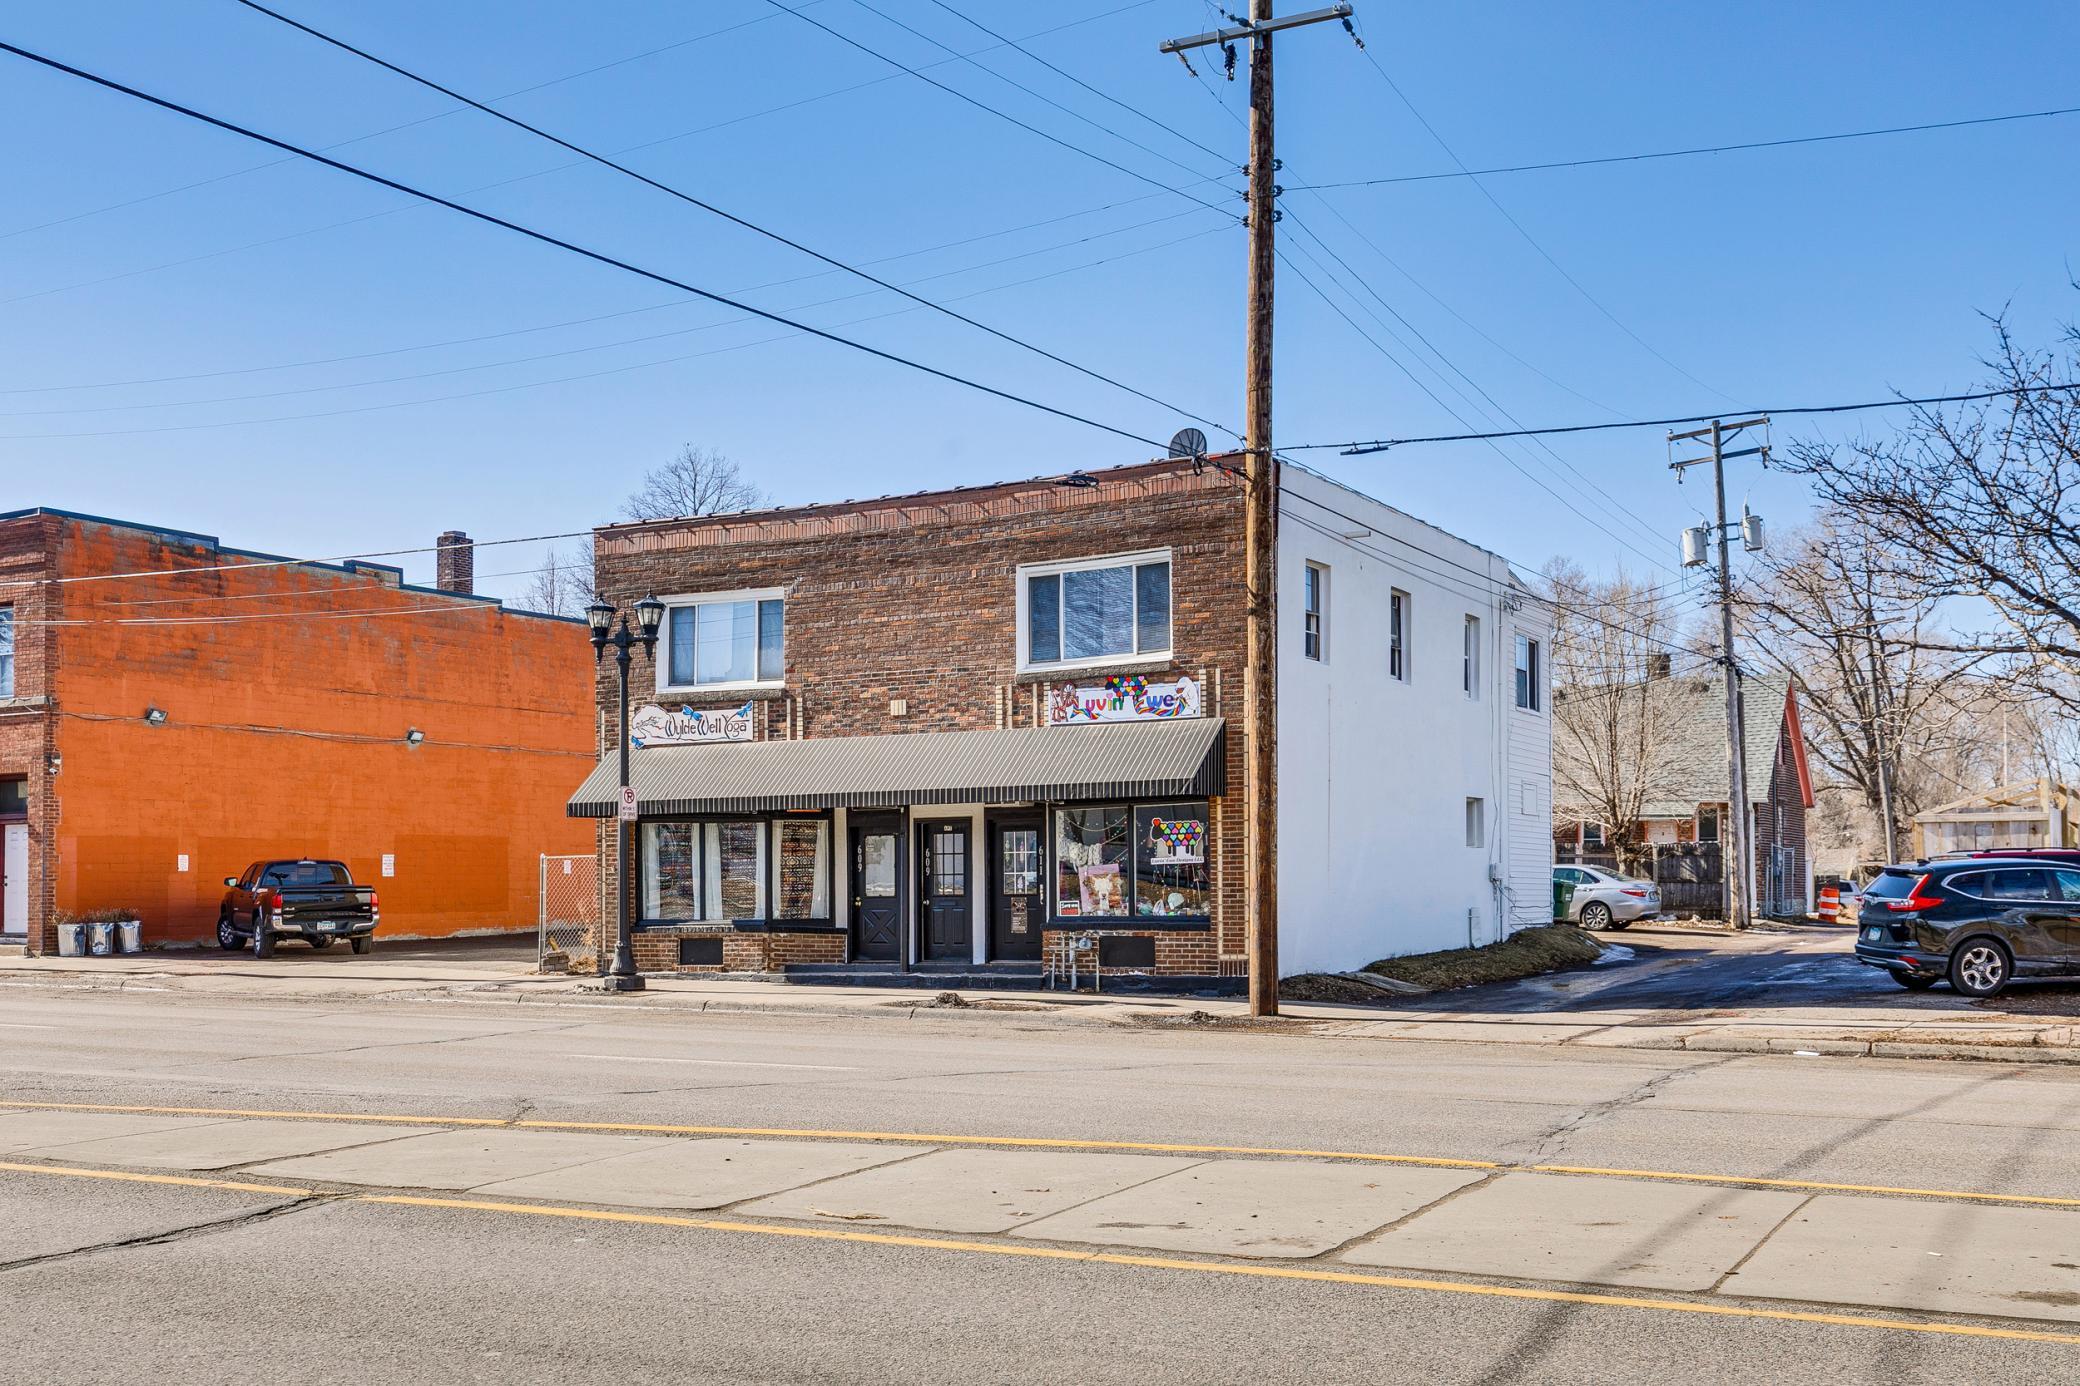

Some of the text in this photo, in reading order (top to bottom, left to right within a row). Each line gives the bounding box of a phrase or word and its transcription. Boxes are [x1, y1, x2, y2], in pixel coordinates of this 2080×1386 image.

[1133, 690, 1174, 714] Ewe
[665, 713, 747, 740] Wylde Well Yoga
